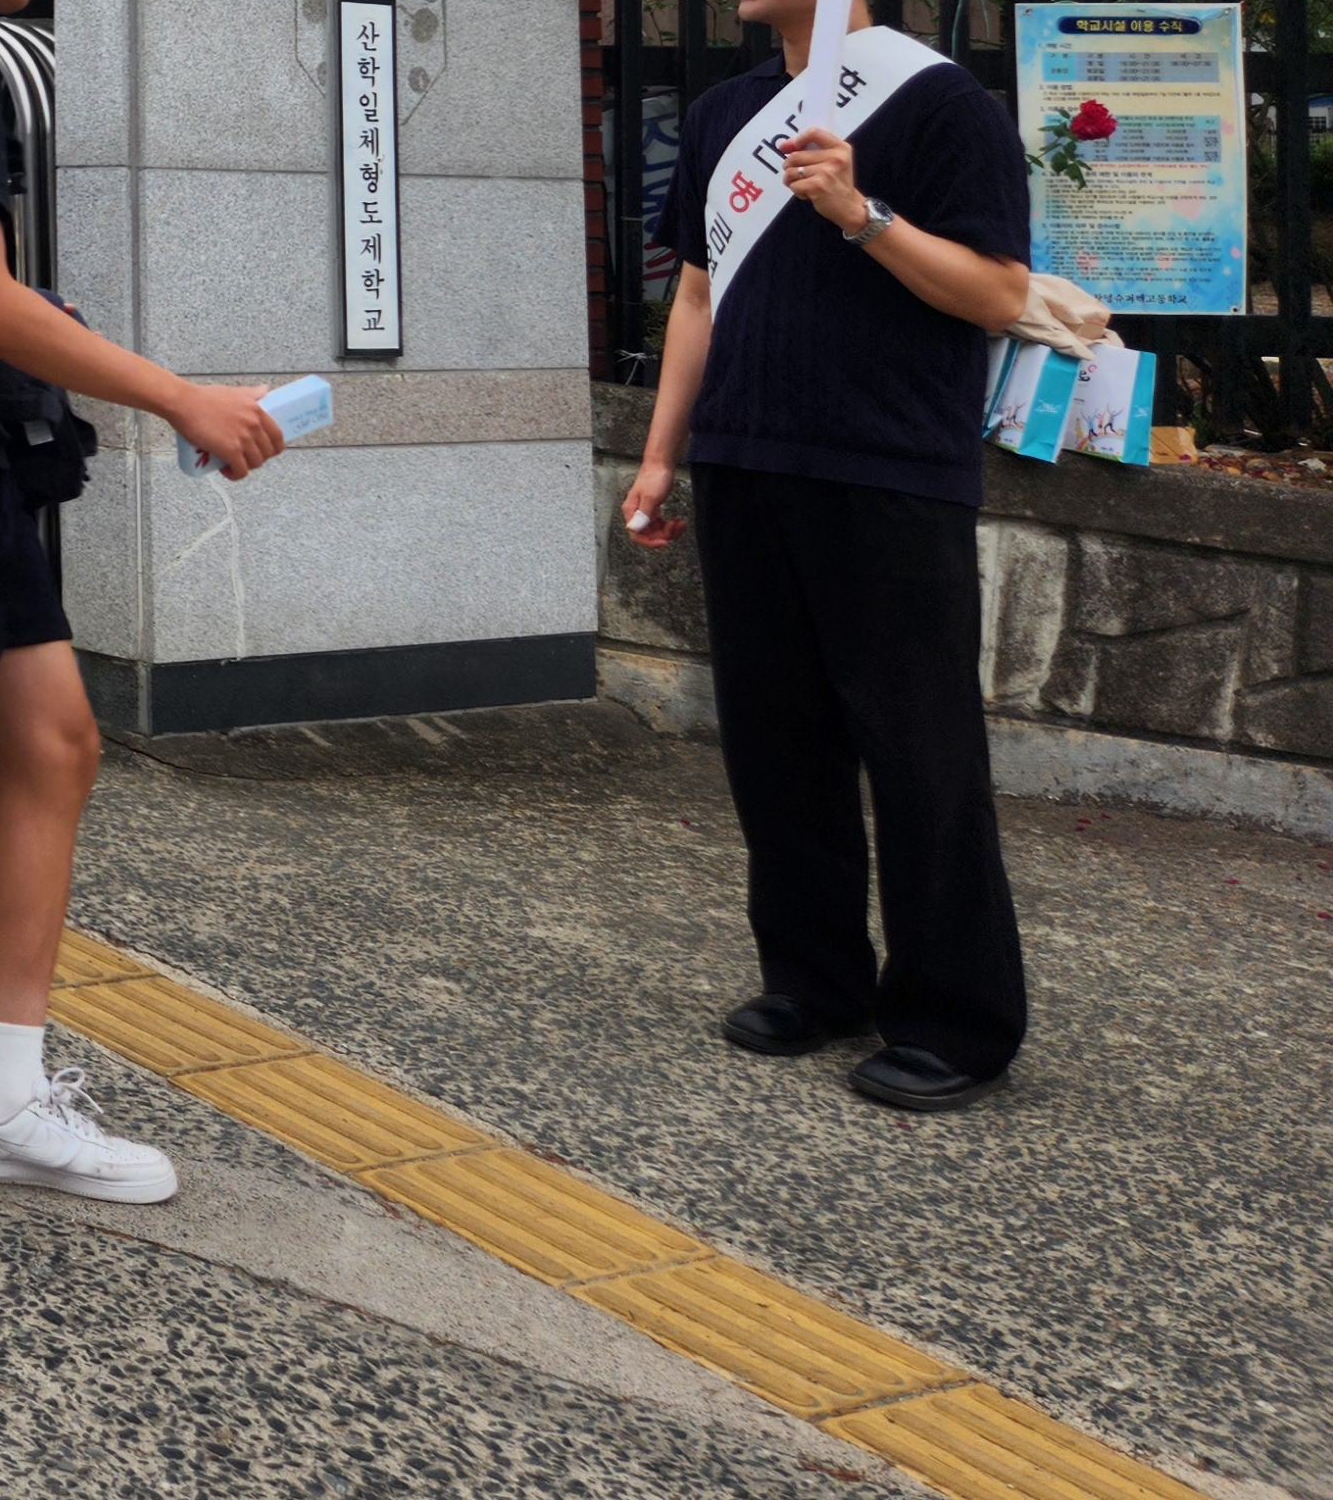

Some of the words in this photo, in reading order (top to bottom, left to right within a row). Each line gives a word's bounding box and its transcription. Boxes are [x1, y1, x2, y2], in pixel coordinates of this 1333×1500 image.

[1076, 19, 1127, 33] 학교시설
[1130, 19, 1155, 33] 이용
[356, 20, 386, 333] 산학일체형도제학교
